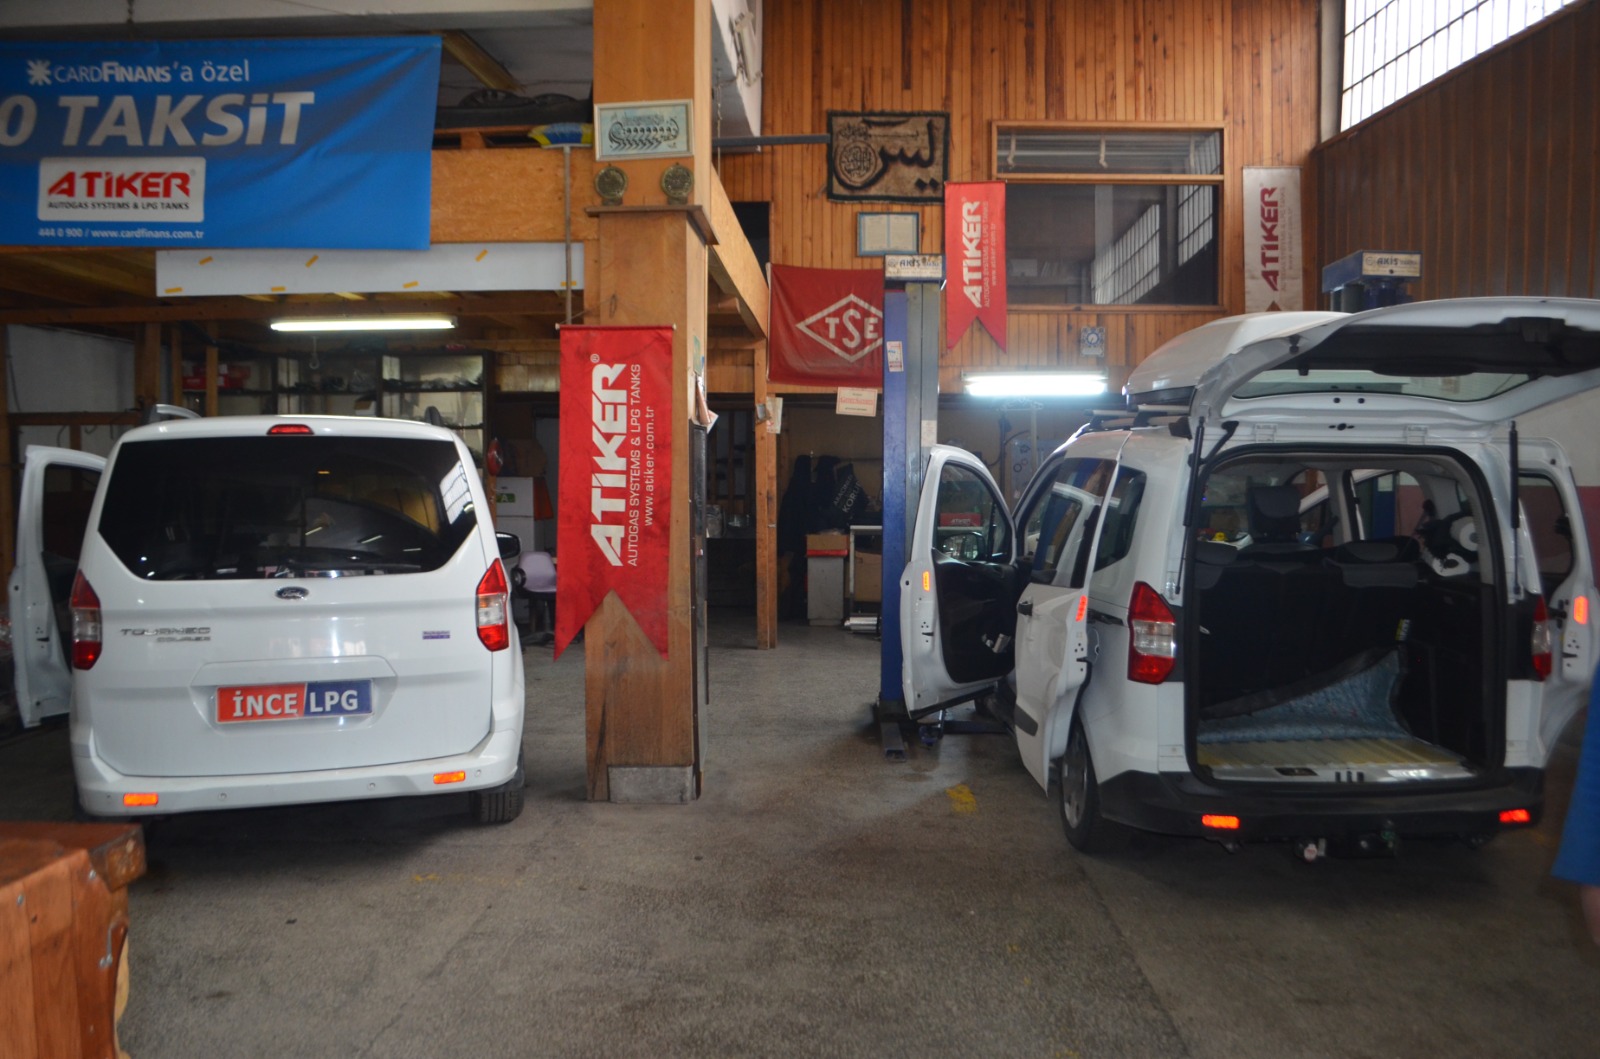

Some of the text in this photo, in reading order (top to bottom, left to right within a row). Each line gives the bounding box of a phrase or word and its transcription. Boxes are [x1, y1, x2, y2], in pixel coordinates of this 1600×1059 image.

[201, 59, 250, 83] özel
[48, 201, 88, 210] AUTOGAS
[91, 201, 130, 210] SYSTEMS
[141, 202, 158, 210] LPG
[160, 201, 190, 210] TANKS
[91, 228, 204, 240] www.cardfinans.com.tr
[825, 309, 878, 348] TSE
[628, 364, 641, 567] AUTOGAS SYSTEMS & LPG TANKS
[644, 406, 655, 527] www.atiker.com.tr
[309, 690, 358, 713] LPG
